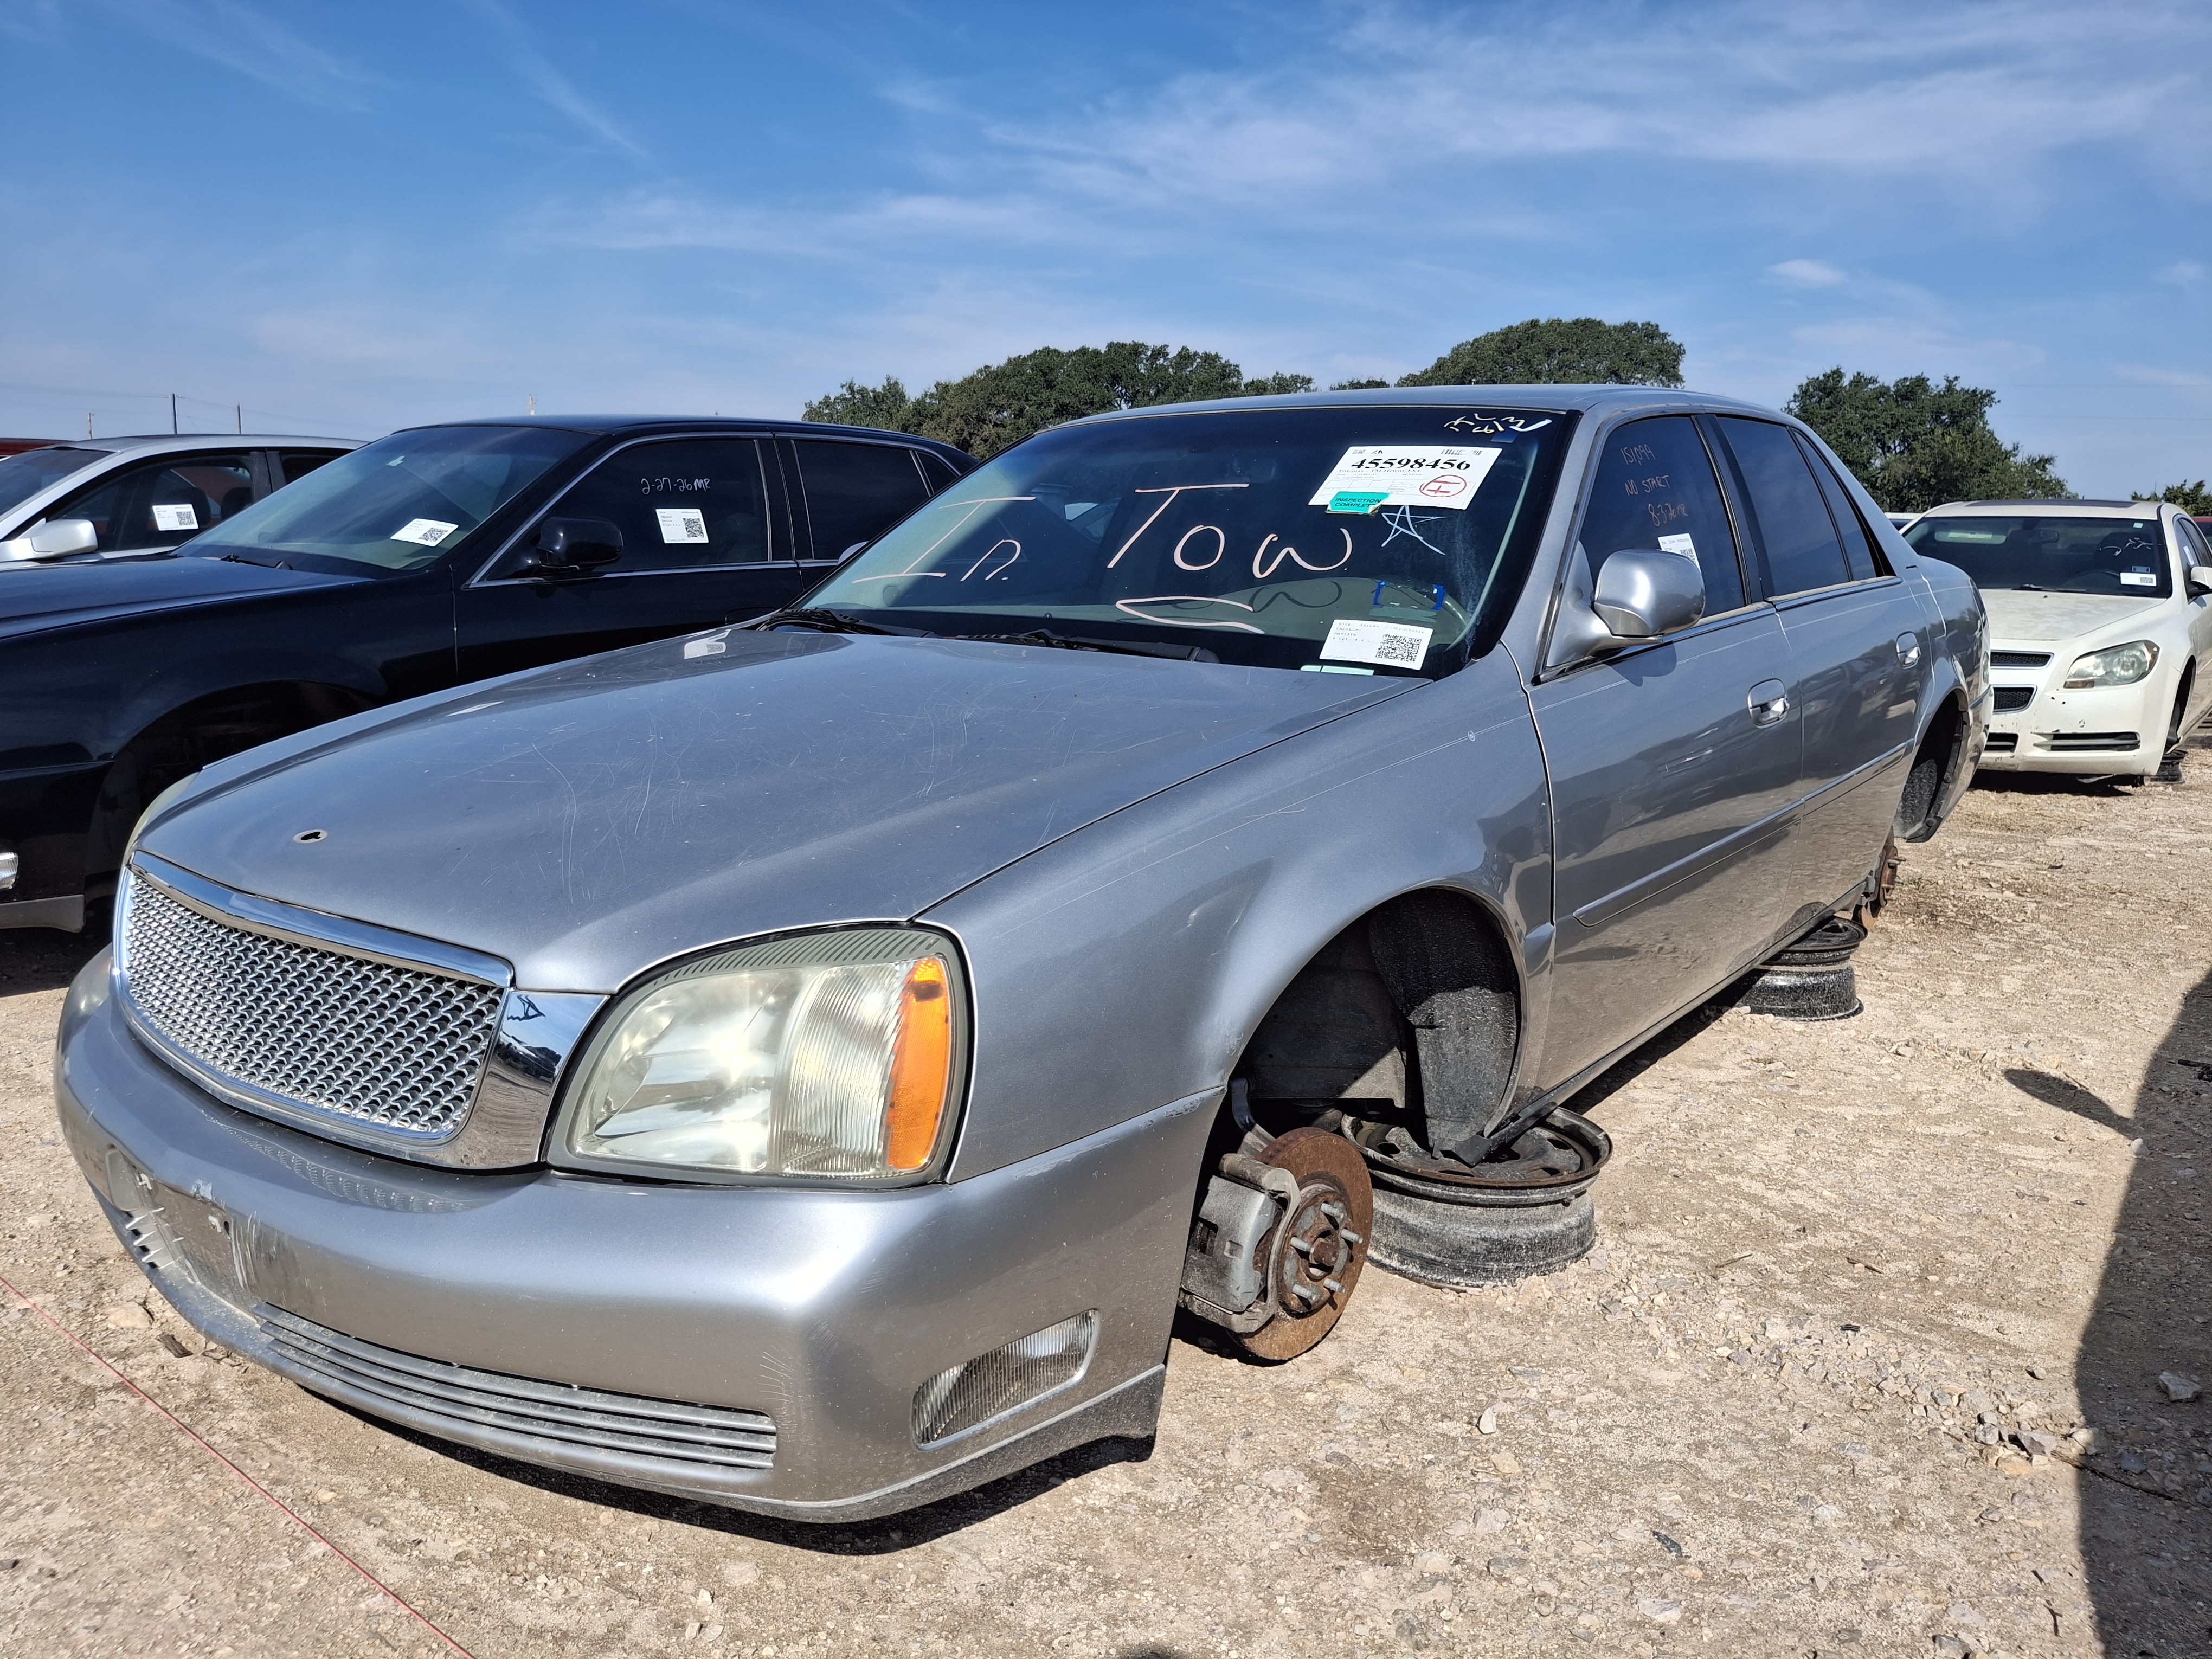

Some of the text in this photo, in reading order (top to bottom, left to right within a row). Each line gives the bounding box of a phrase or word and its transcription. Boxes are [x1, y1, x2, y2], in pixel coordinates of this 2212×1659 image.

[1351, 458, 1471, 470] 45598456
[1625, 475, 1670, 497] NO START
[1107, 484, 1353, 578] Tow
